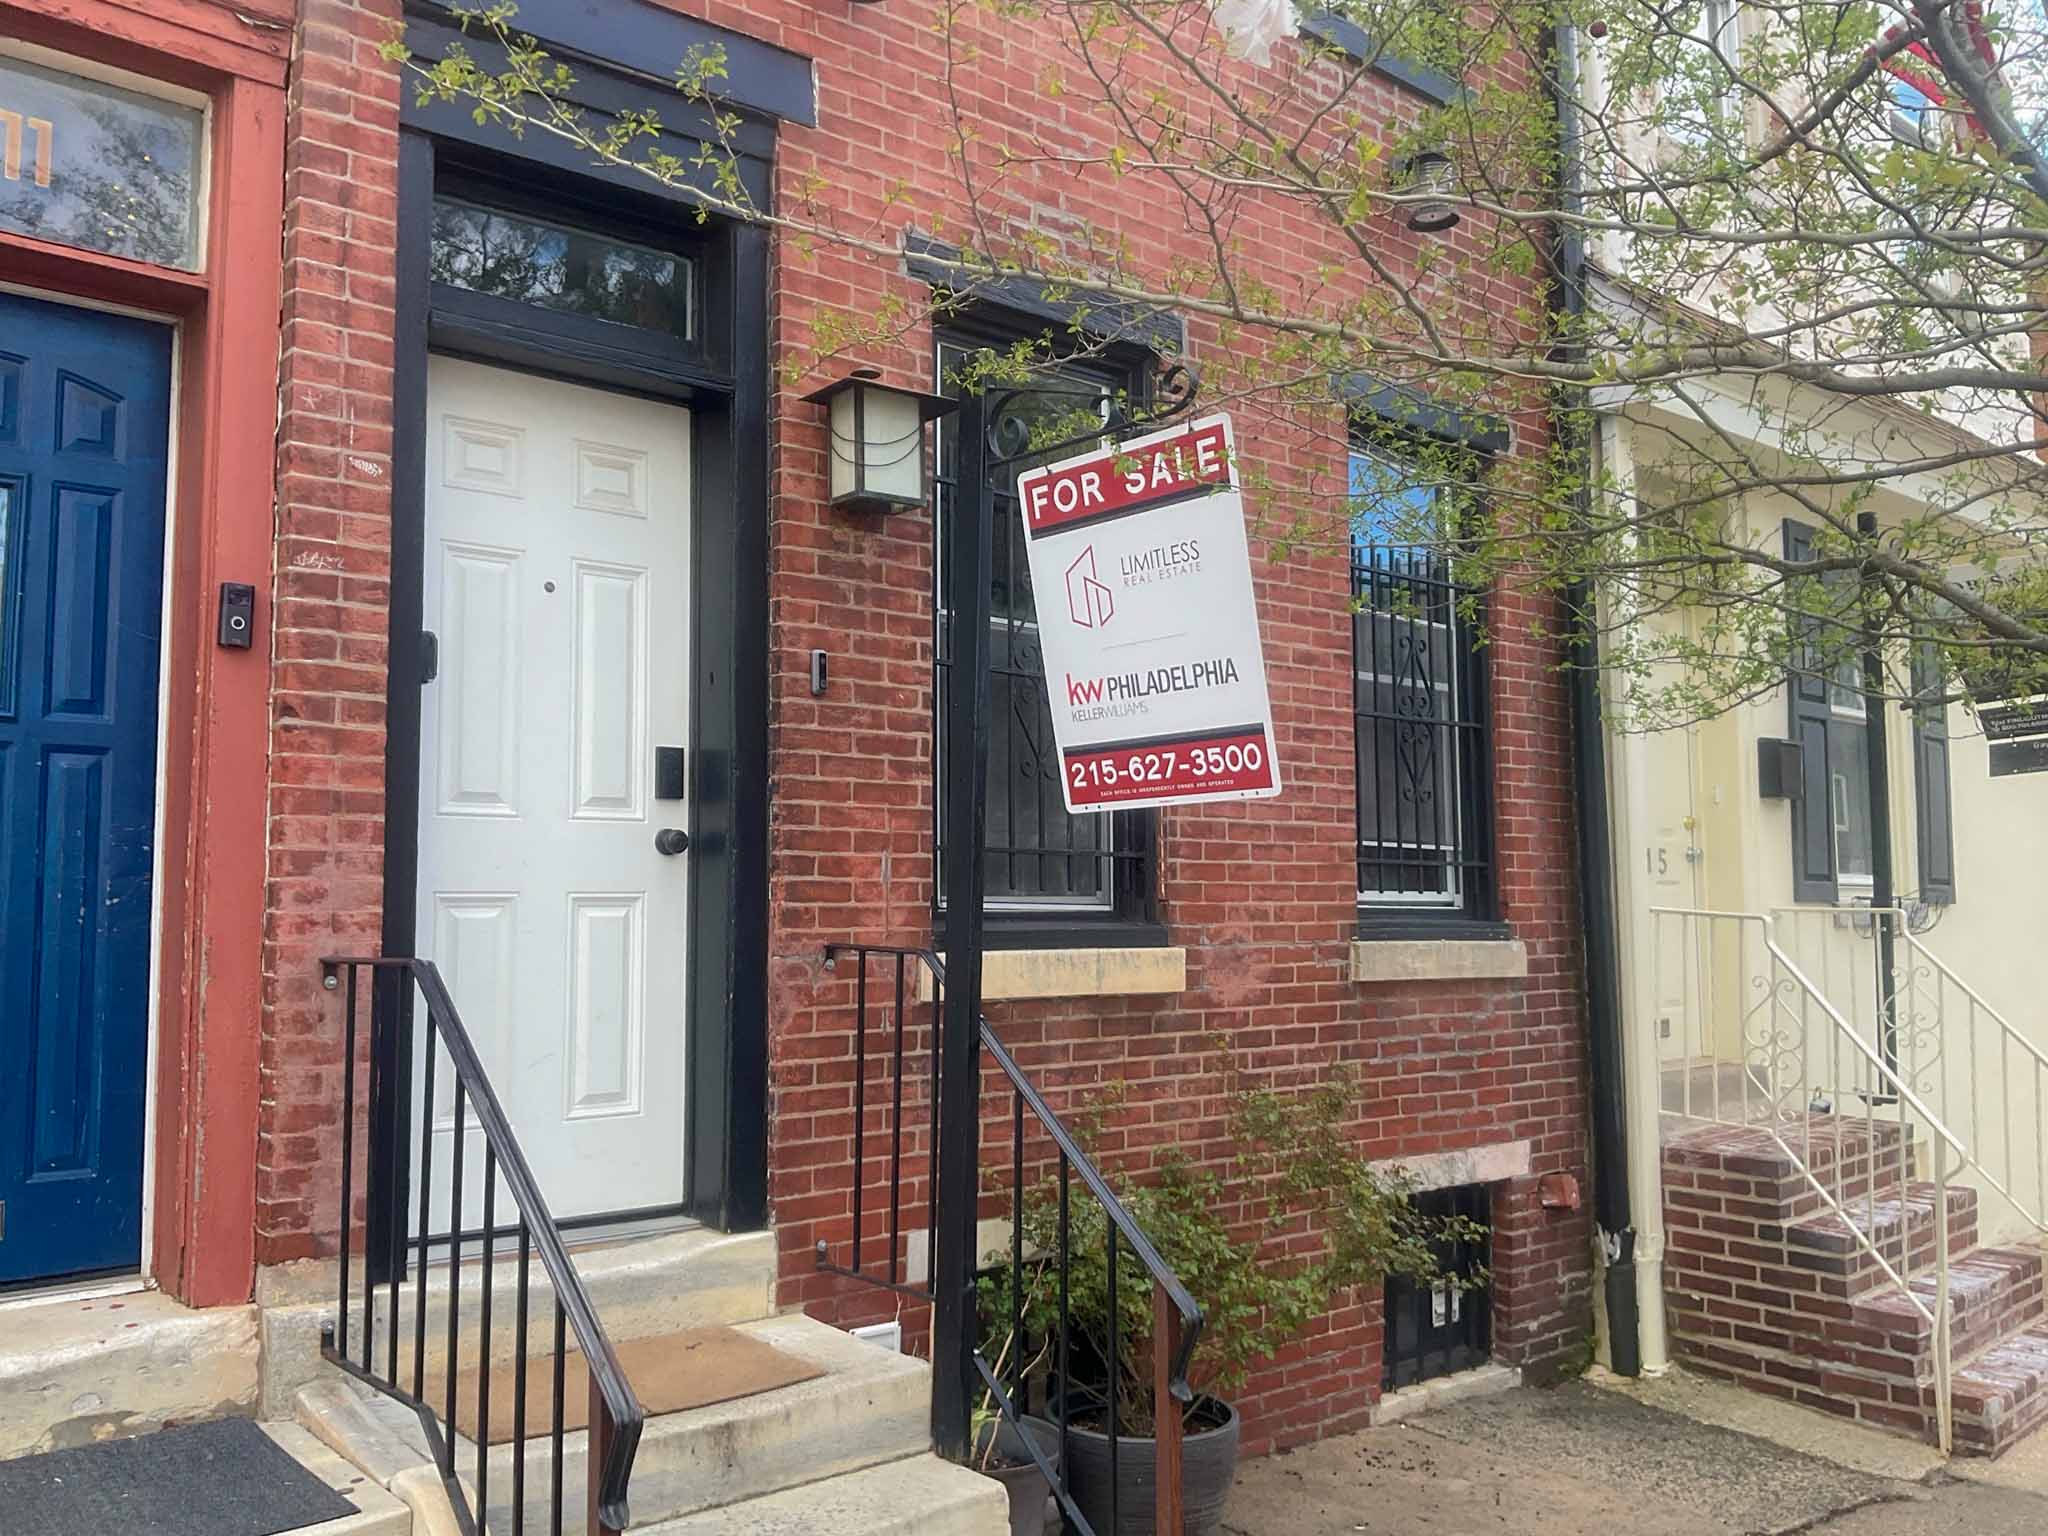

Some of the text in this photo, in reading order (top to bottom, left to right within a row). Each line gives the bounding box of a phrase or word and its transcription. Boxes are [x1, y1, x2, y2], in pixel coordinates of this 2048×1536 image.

[1031, 436, 1221, 520] FOR SALE
[1120, 540, 1200, 576] LIMITLESS
[1123, 561, 1201, 587] REAL ESTATE
[1107, 657, 1239, 701] PHILADELPHIA
[1071, 742, 1262, 788] 215-627-3500
[1646, 847, 1668, 875] 15
